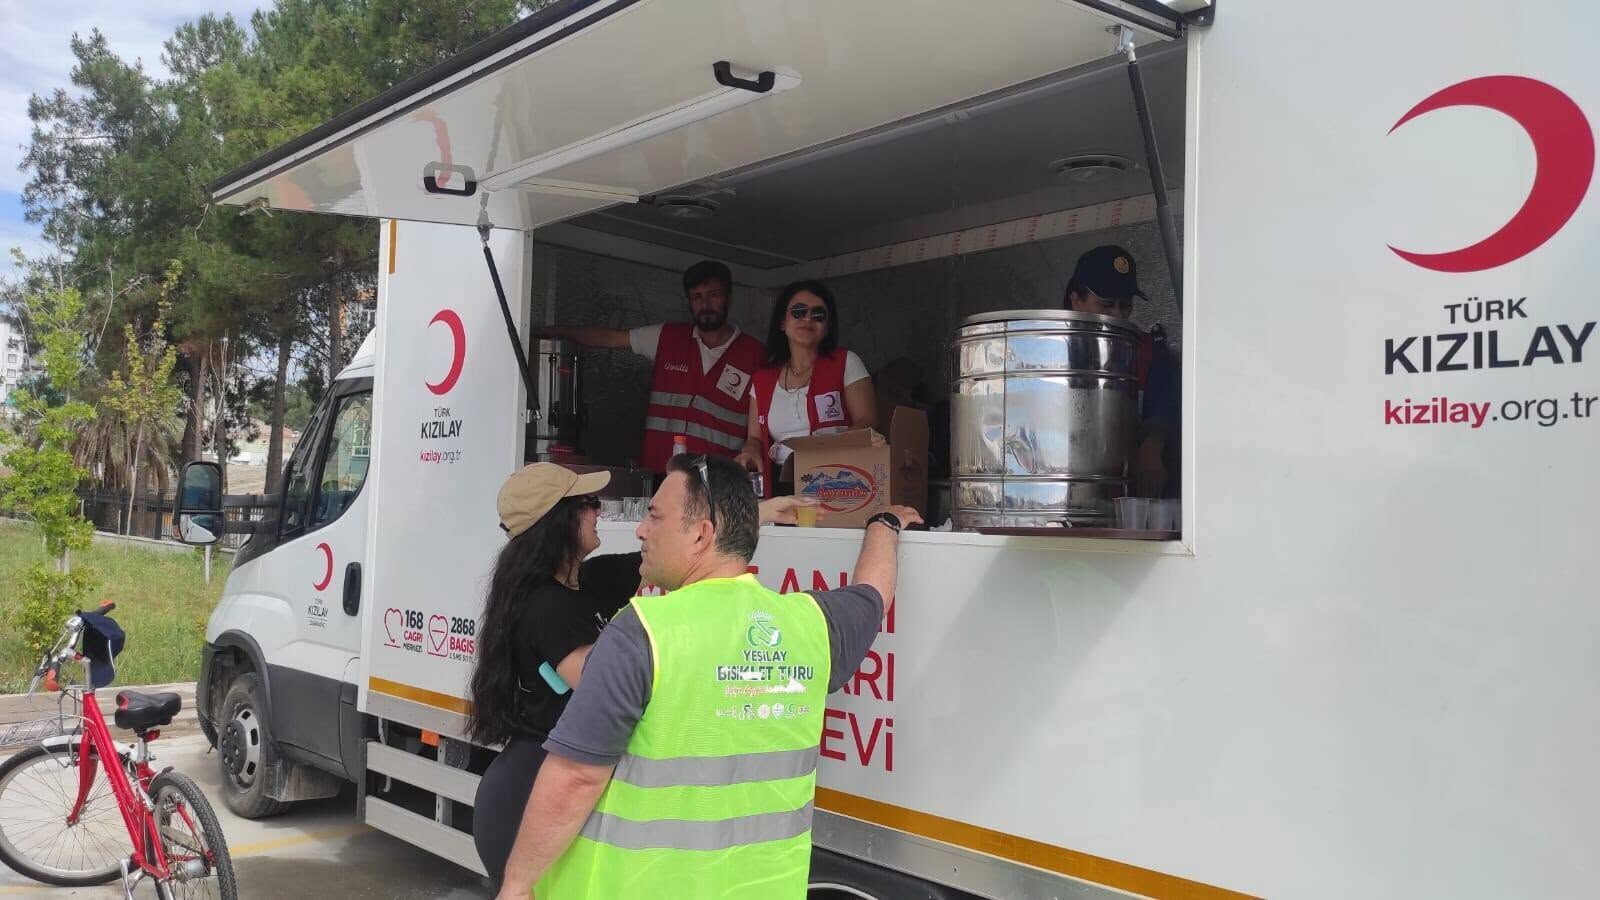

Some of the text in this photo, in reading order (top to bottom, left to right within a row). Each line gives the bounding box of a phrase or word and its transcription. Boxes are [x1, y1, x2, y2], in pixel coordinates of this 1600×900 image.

[1443, 297, 1528, 324] TÜRK
[1384, 321, 1598, 375] KIZILAY
[433, 406, 451, 418] TÜRK
[1384, 392, 1599, 428] kizilay.org.tr
[420, 420, 463, 439] KIZILAY
[405, 610, 424, 629] 168
[450, 616, 475, 636] 2868
[778, 666, 814, 681] TURU
